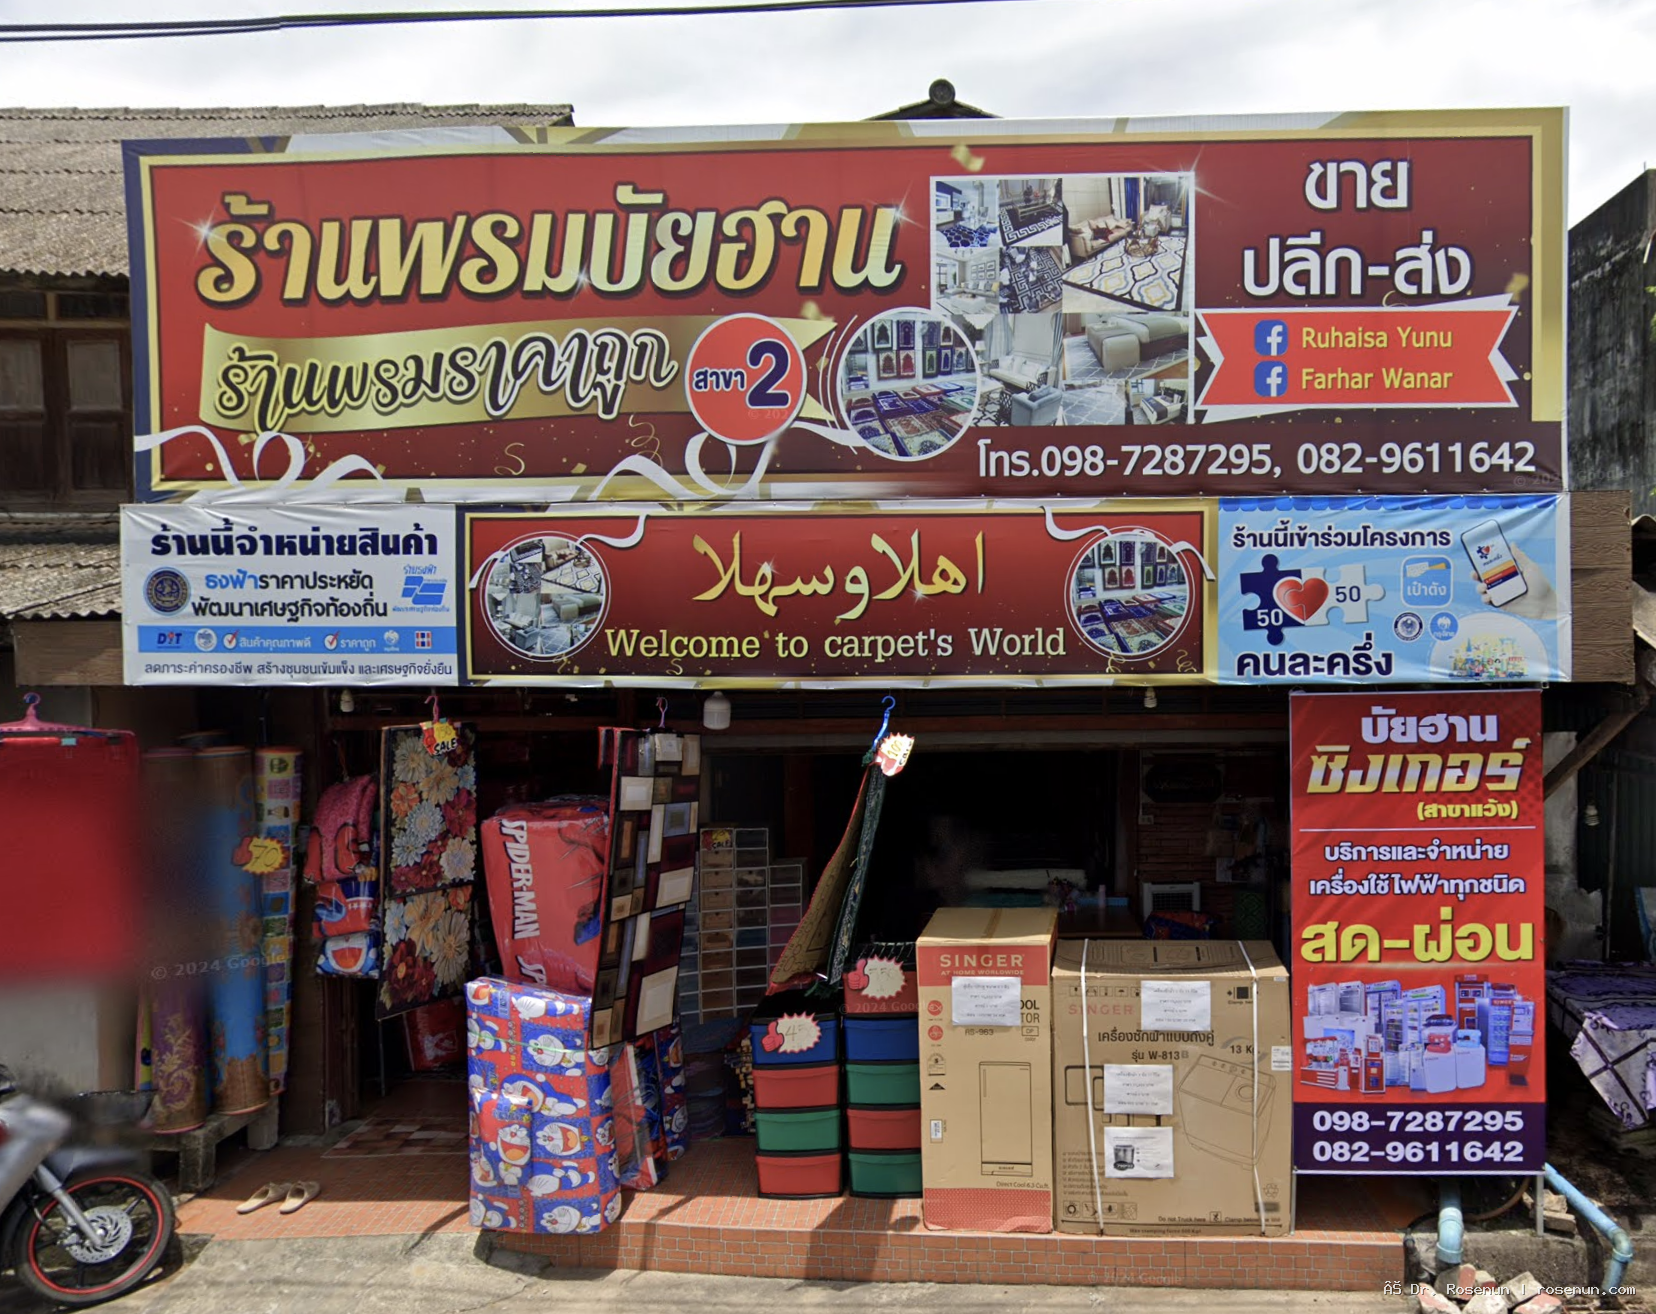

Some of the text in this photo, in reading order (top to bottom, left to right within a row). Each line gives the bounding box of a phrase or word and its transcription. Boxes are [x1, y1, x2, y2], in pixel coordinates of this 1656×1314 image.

[1305, 160, 1408, 208] ขาย
[197, 184, 902, 302] ร้านพรมบัยฮาน
[1244, 231, 1470, 296] ปลีก-ส่ง
[1301, 327, 1452, 349] Ruhaisa Yunu
[215, 330, 676, 430] ร้านพรมราคาถูก
[693, 337, 790, 409] สาขา 2
[1301, 368, 1452, 390] Farhar Wanar
[978, 438, 1536, 479] โทร.098-7287295, 082-9611642
[151, 518, 438, 556] ร้านนี้จำหน่ายสินค้า
[1232, 519, 1451, 548] ร้านนี้เข้าร่วมโครงการ
[205, 568, 374, 590] ธงฟ้าราคาประหยัด
[1335, 585, 1361, 602] 50
[1256, 609, 1284, 627] 50
[605, 627, 1067, 663] Welcome to carpet's World
[1236, 632, 1393, 677] คนละครึ่ง
[145, 661, 253, 674] ลดภาระค่าครองชีพ
[1361, 706, 1499, 744] บัยฮาน
[433, 737, 457, 756] SALE
[1416, 799, 1519, 821] (สาขาแว้ง)
[1324, 839, 1510, 862] บริการและจำหน่าย
[499, 817, 541, 940] SPIDER-MAN
[1301, 906, 1534, 963] สด-ผ่อน
[940, 954, 1024, 968] SINGER
[1230, 1044, 1242, 1055] 13
[1312, 1110, 1524, 1132] 098-7287295
[1312, 1141, 1524, 1162] 082-9611642
